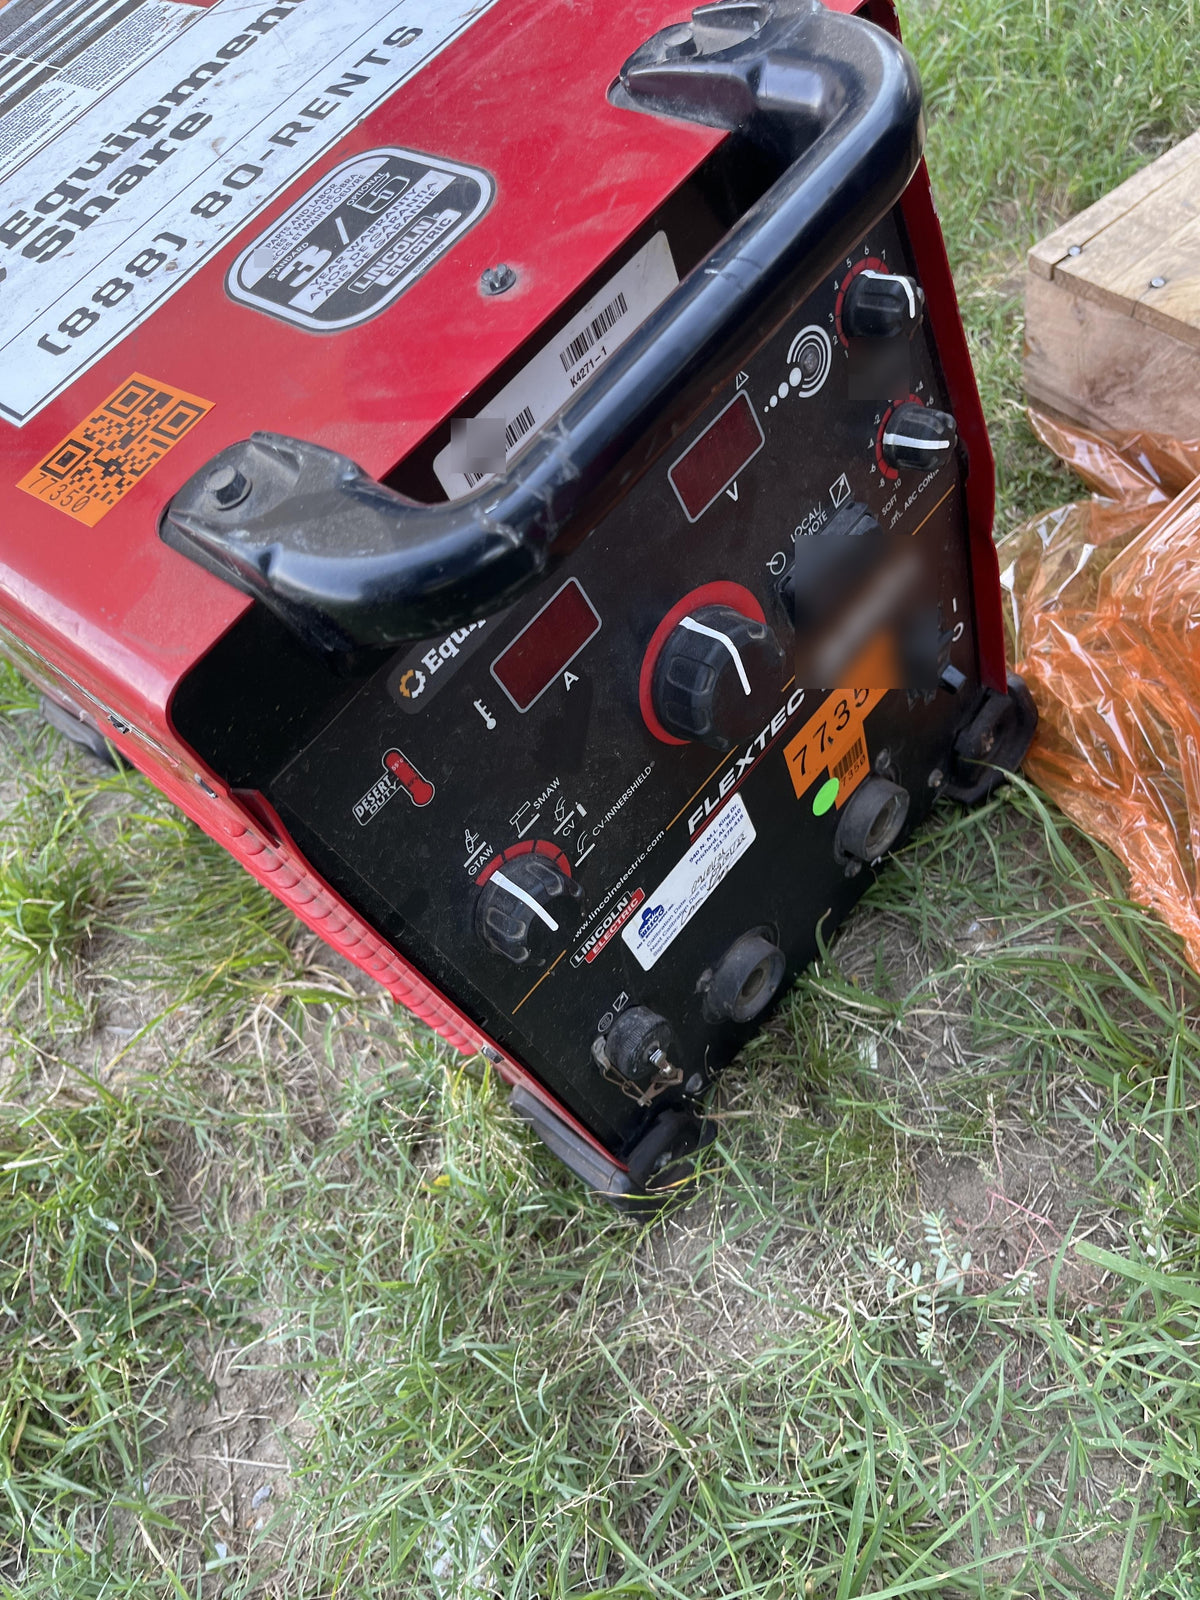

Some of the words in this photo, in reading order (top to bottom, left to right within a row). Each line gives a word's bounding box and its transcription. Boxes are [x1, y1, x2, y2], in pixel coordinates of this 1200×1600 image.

[0, 0, 300, 250] Equipmen
[190, 26, 423, 219] 80-RENTS
[266, 226, 290, 249] PARTS
[291, 208, 310, 226] AND
[312, 183, 337, 208] LABOR
[295, 205, 321, 231] MANO
[321, 195, 334, 208] DE
[333, 174, 358, 196] OBRA
[292, 229, 303, 241] ET
[302, 211, 326, 232] MAIN
[310, 255, 346, 286] YEAR
[347, 188, 417, 253] WARRANTY
[325, 271, 352, 297] ANS
[353, 252, 372, 269] DE
[373, 189, 439, 249] GARANTIE
[268, 242, 309, 279] STANDARD
[350, 245, 368, 261] DE
[387, 218, 452, 277] ELECTRIC
[846, 258, 852, 268] 5
[864, 245, 870, 255] 6
[834, 280, 839, 290] 4
[828, 313, 834, 322] 3
[28, 472, 91, 513] 77350
[725, 481, 741, 502] V
[881, 494, 898, 517] SOFT
[904, 491, 918, 511] ARC
[563, 670, 580, 692] A
[355, 775, 391, 818] DESERT
[369, 777, 400, 815] DUTY
[533, 777, 560, 810] SMAW
[562, 820, 576, 836] CV
[467, 845, 494, 876] GTAW
[574, 896, 629, 962] LINCOLN
[592, 897, 639, 954] ELECTRIC
